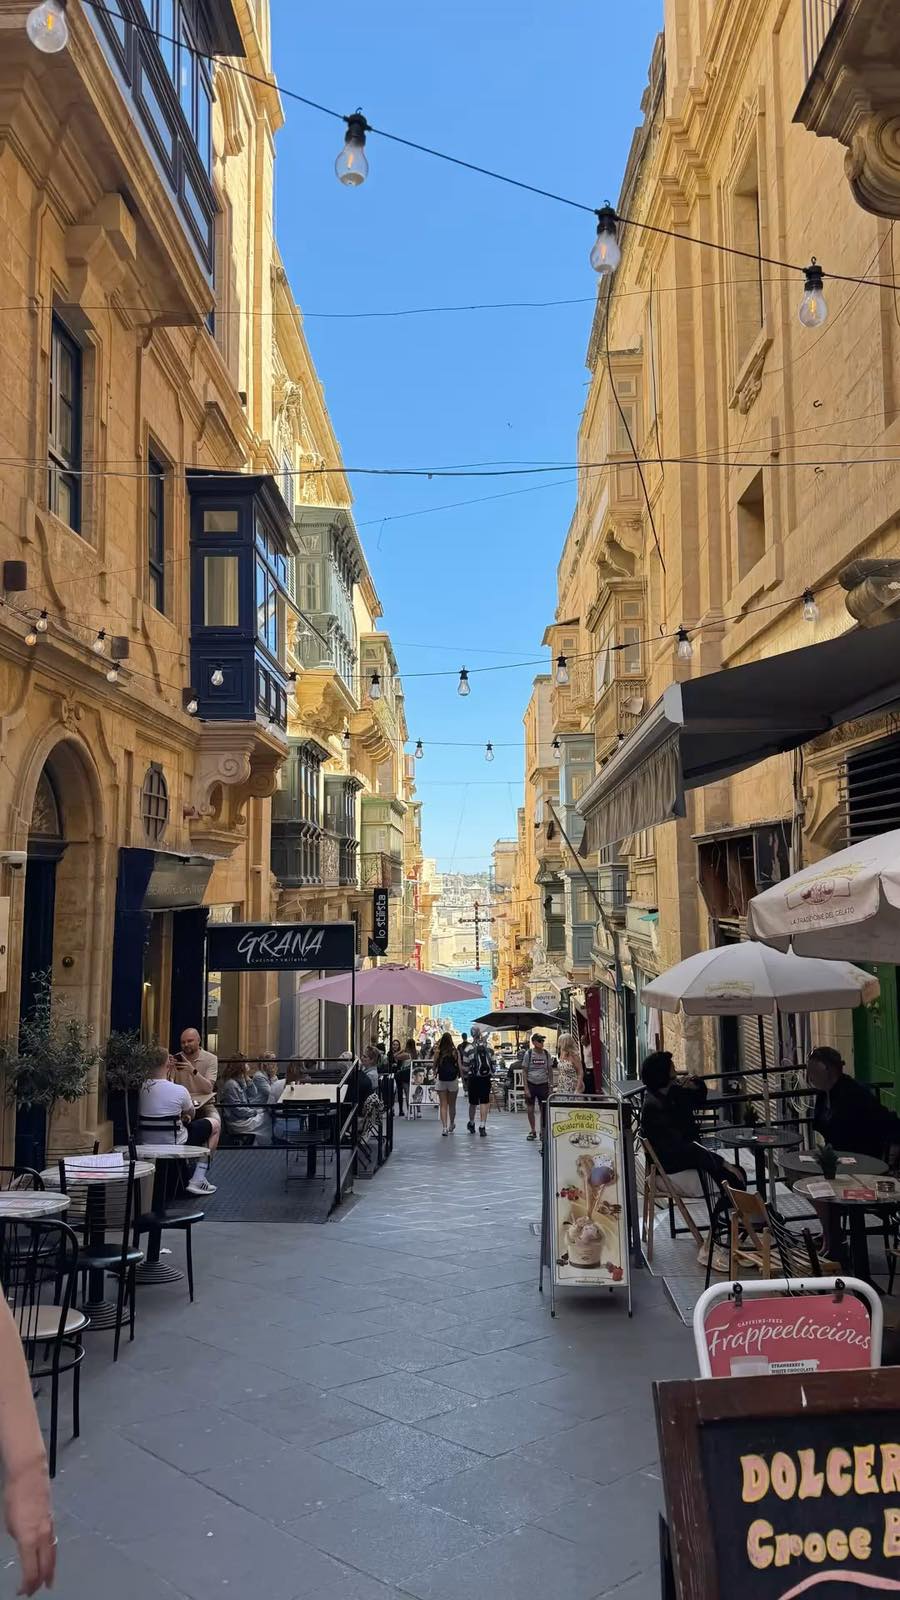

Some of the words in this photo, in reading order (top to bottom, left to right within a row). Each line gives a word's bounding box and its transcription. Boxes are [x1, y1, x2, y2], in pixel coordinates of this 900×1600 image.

[237, 928, 326, 964] GRANA
[376, 930, 386, 938] lo
[705, 1316, 872, 1356] Frappeeliscious
[740, 1443, 900, 1502] DOLCER
